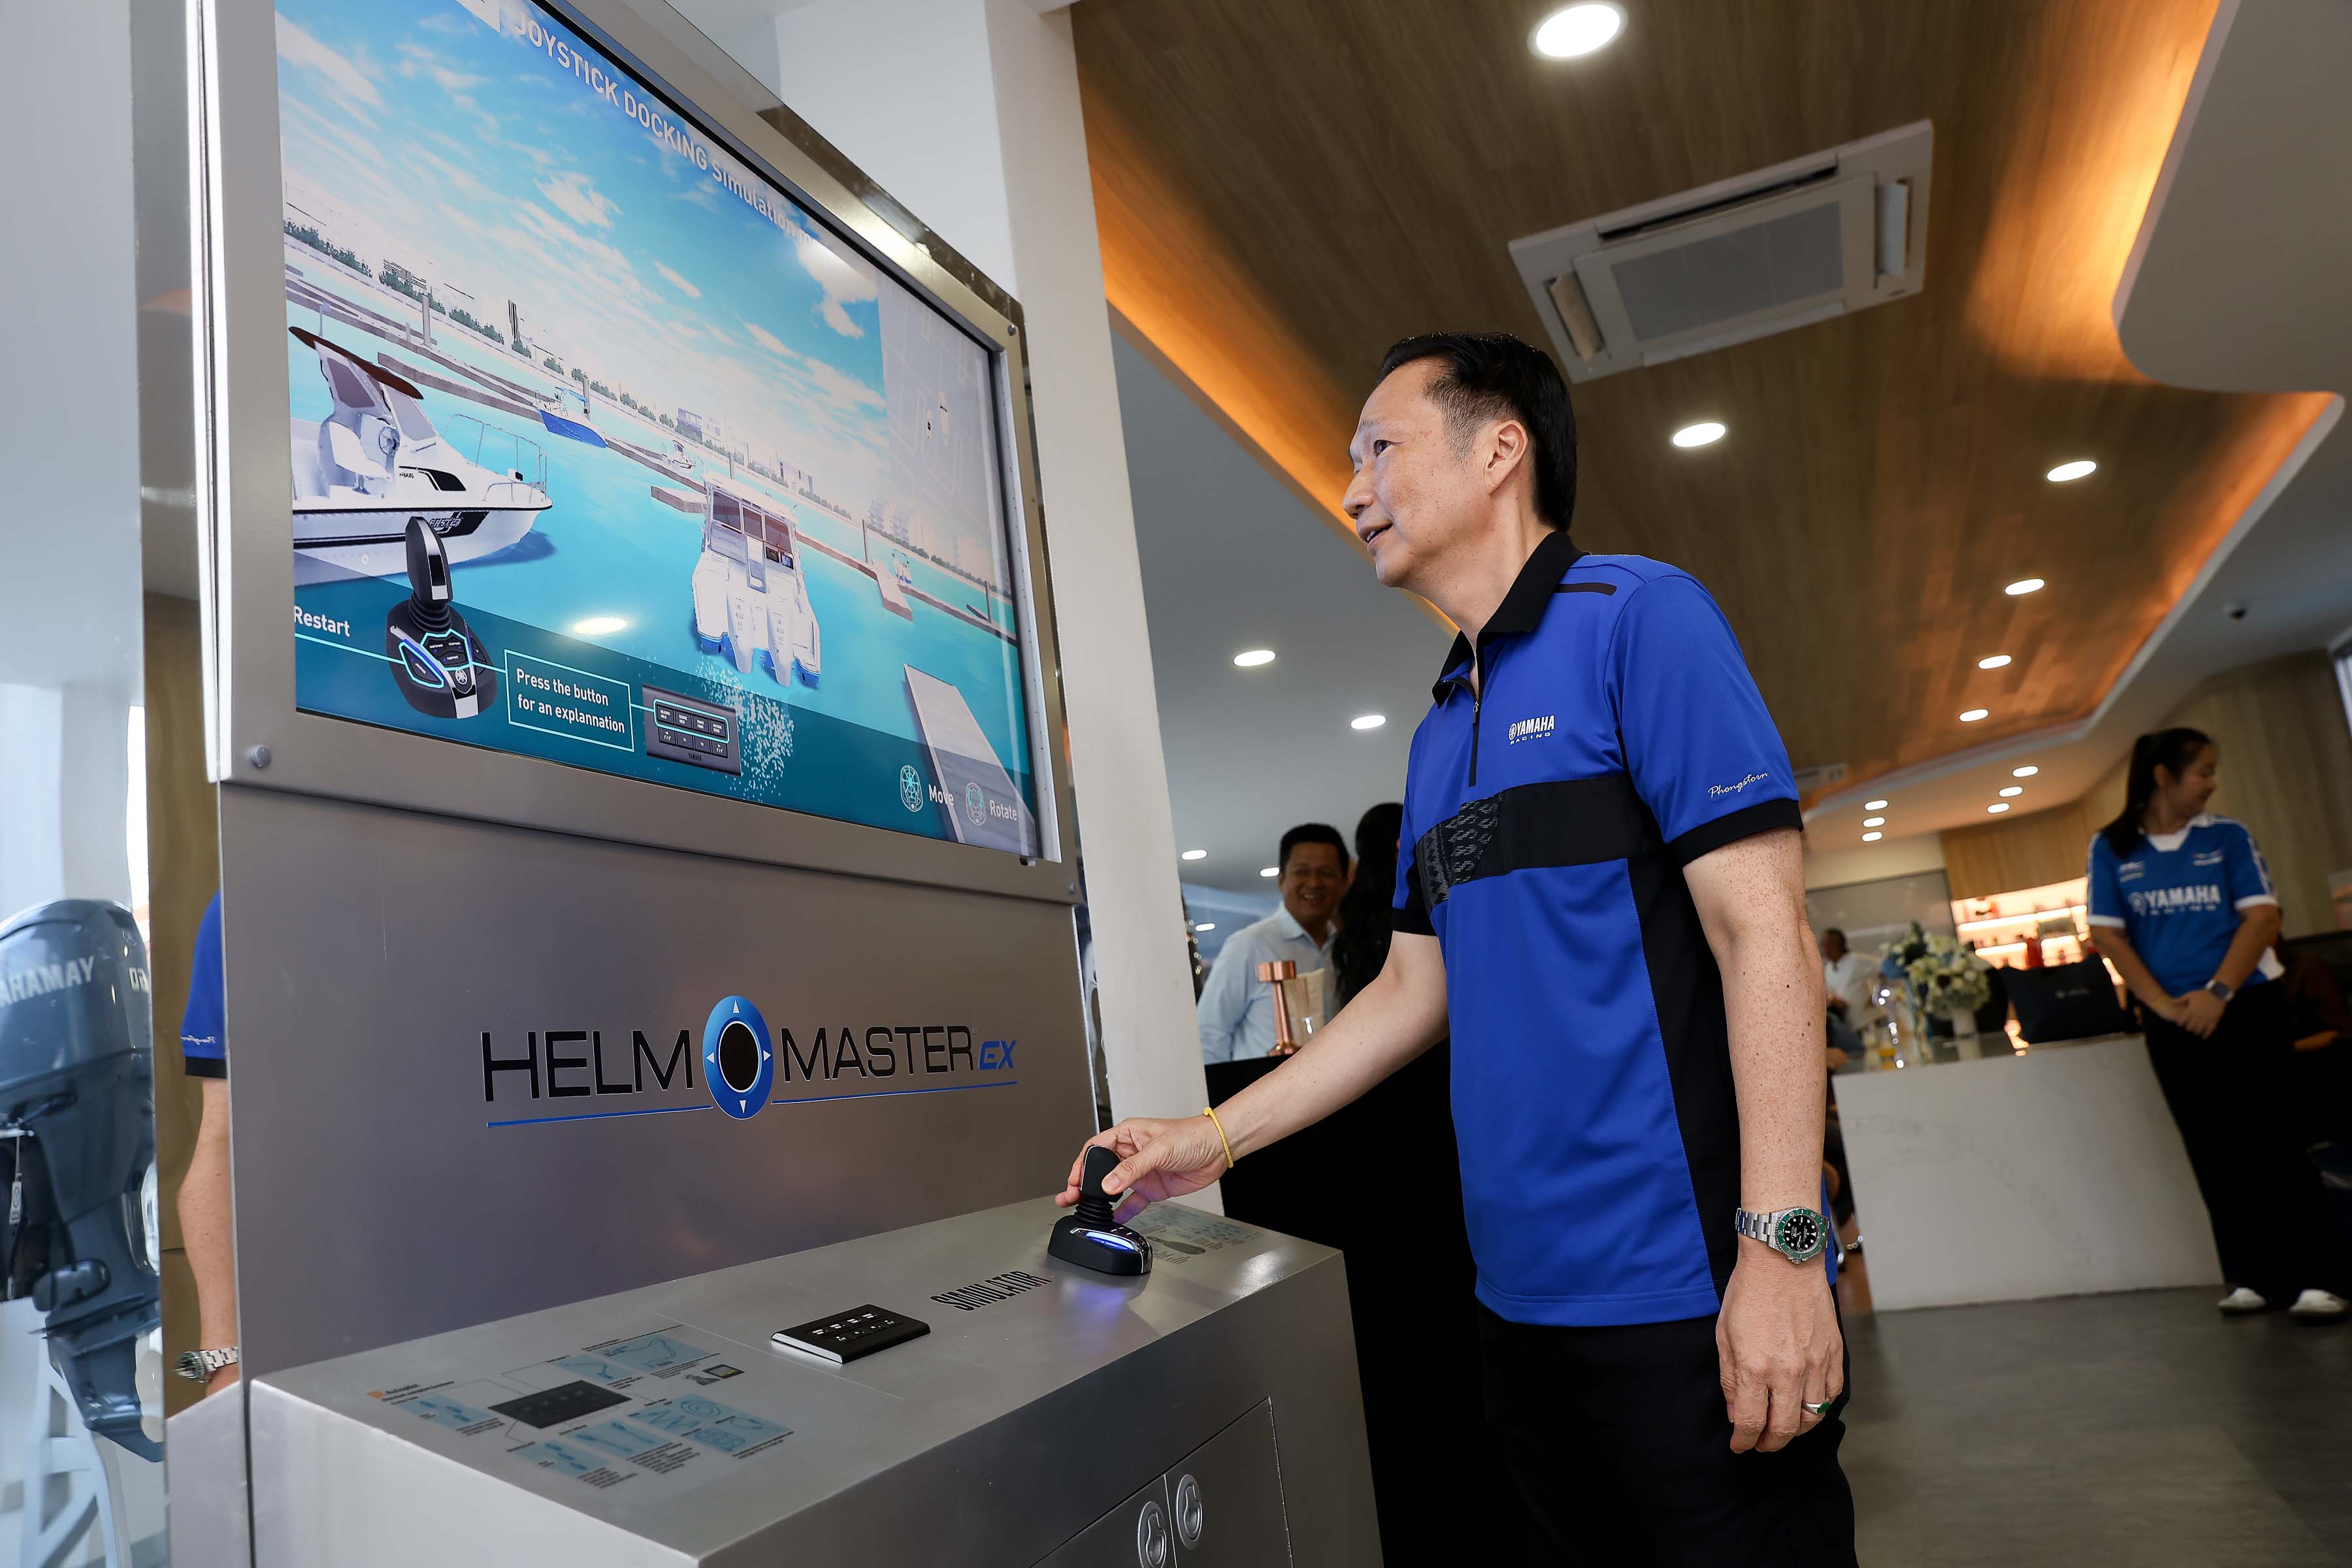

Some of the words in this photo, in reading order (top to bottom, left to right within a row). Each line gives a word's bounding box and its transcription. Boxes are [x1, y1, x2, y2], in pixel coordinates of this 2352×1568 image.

[515, 12, 620, 108] JOYSTICK
[623, 90, 708, 171] DOCKING
[711, 157, 795, 238] Simulation
[294, 605, 350, 637] Restart
[516, 668, 551, 691] Press
[553, 679, 571, 696] the
[574, 683, 610, 706] button
[517, 693, 536, 711] for
[538, 702, 553, 716] an
[555, 706, 625, 734] explannation
[1516, 715, 1554, 737] YAMAHA
[1510, 732, 1551, 745] RACING
[928, 784, 955, 806] Move
[989, 799, 1017, 821] Rotate
[2144, 883, 2221, 909] YAMAHA
[481, 1028, 694, 1102] HELM
[781, 1025, 974, 1083] MASTER
[978, 1039, 1018, 1071] EX
[930, 1271, 1053, 1312] SIMULATOR
